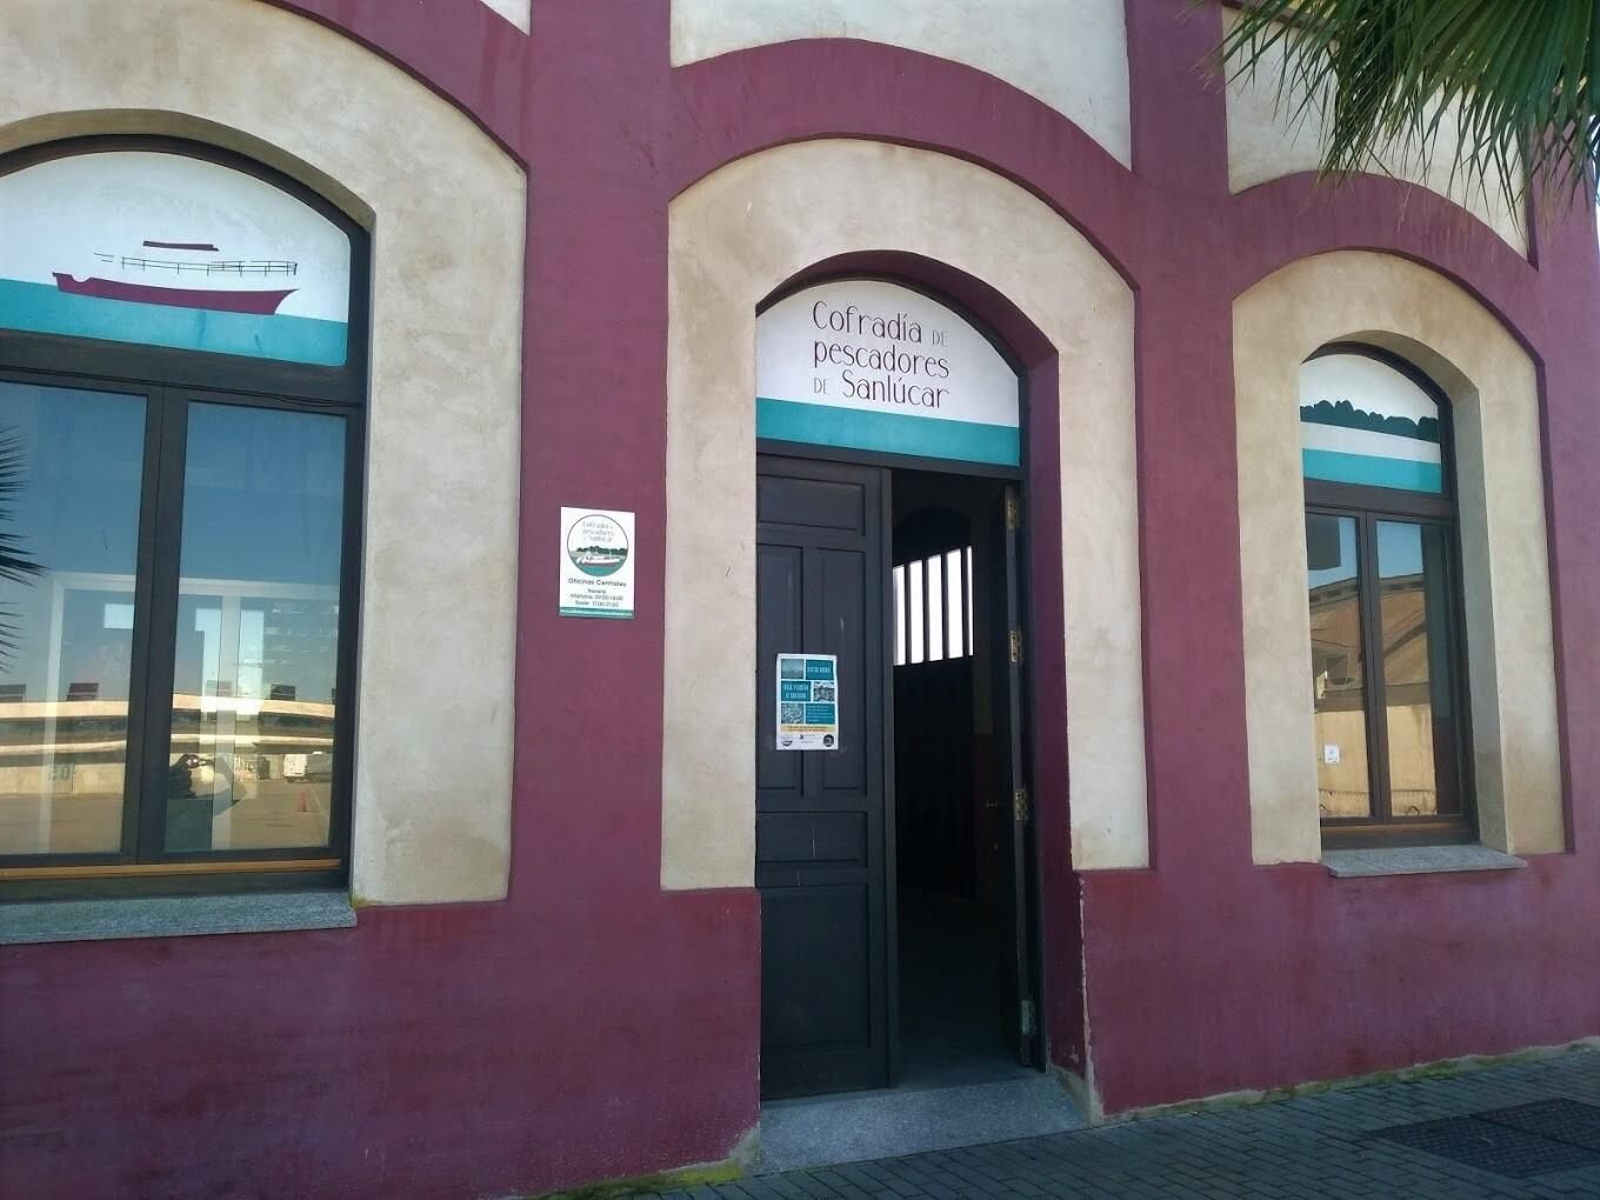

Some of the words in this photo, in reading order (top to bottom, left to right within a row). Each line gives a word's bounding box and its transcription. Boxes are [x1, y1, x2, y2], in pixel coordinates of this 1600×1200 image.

[813, 300, 922, 344] Cofradía
[932, 329, 950, 347] DE
[814, 340, 950, 379] pescadores
[813, 377, 830, 395] DE
[841, 369, 950, 408] Sanlúcar
[568, 577, 594, 586] Oficinas
[596, 579, 627, 587] Centrales
